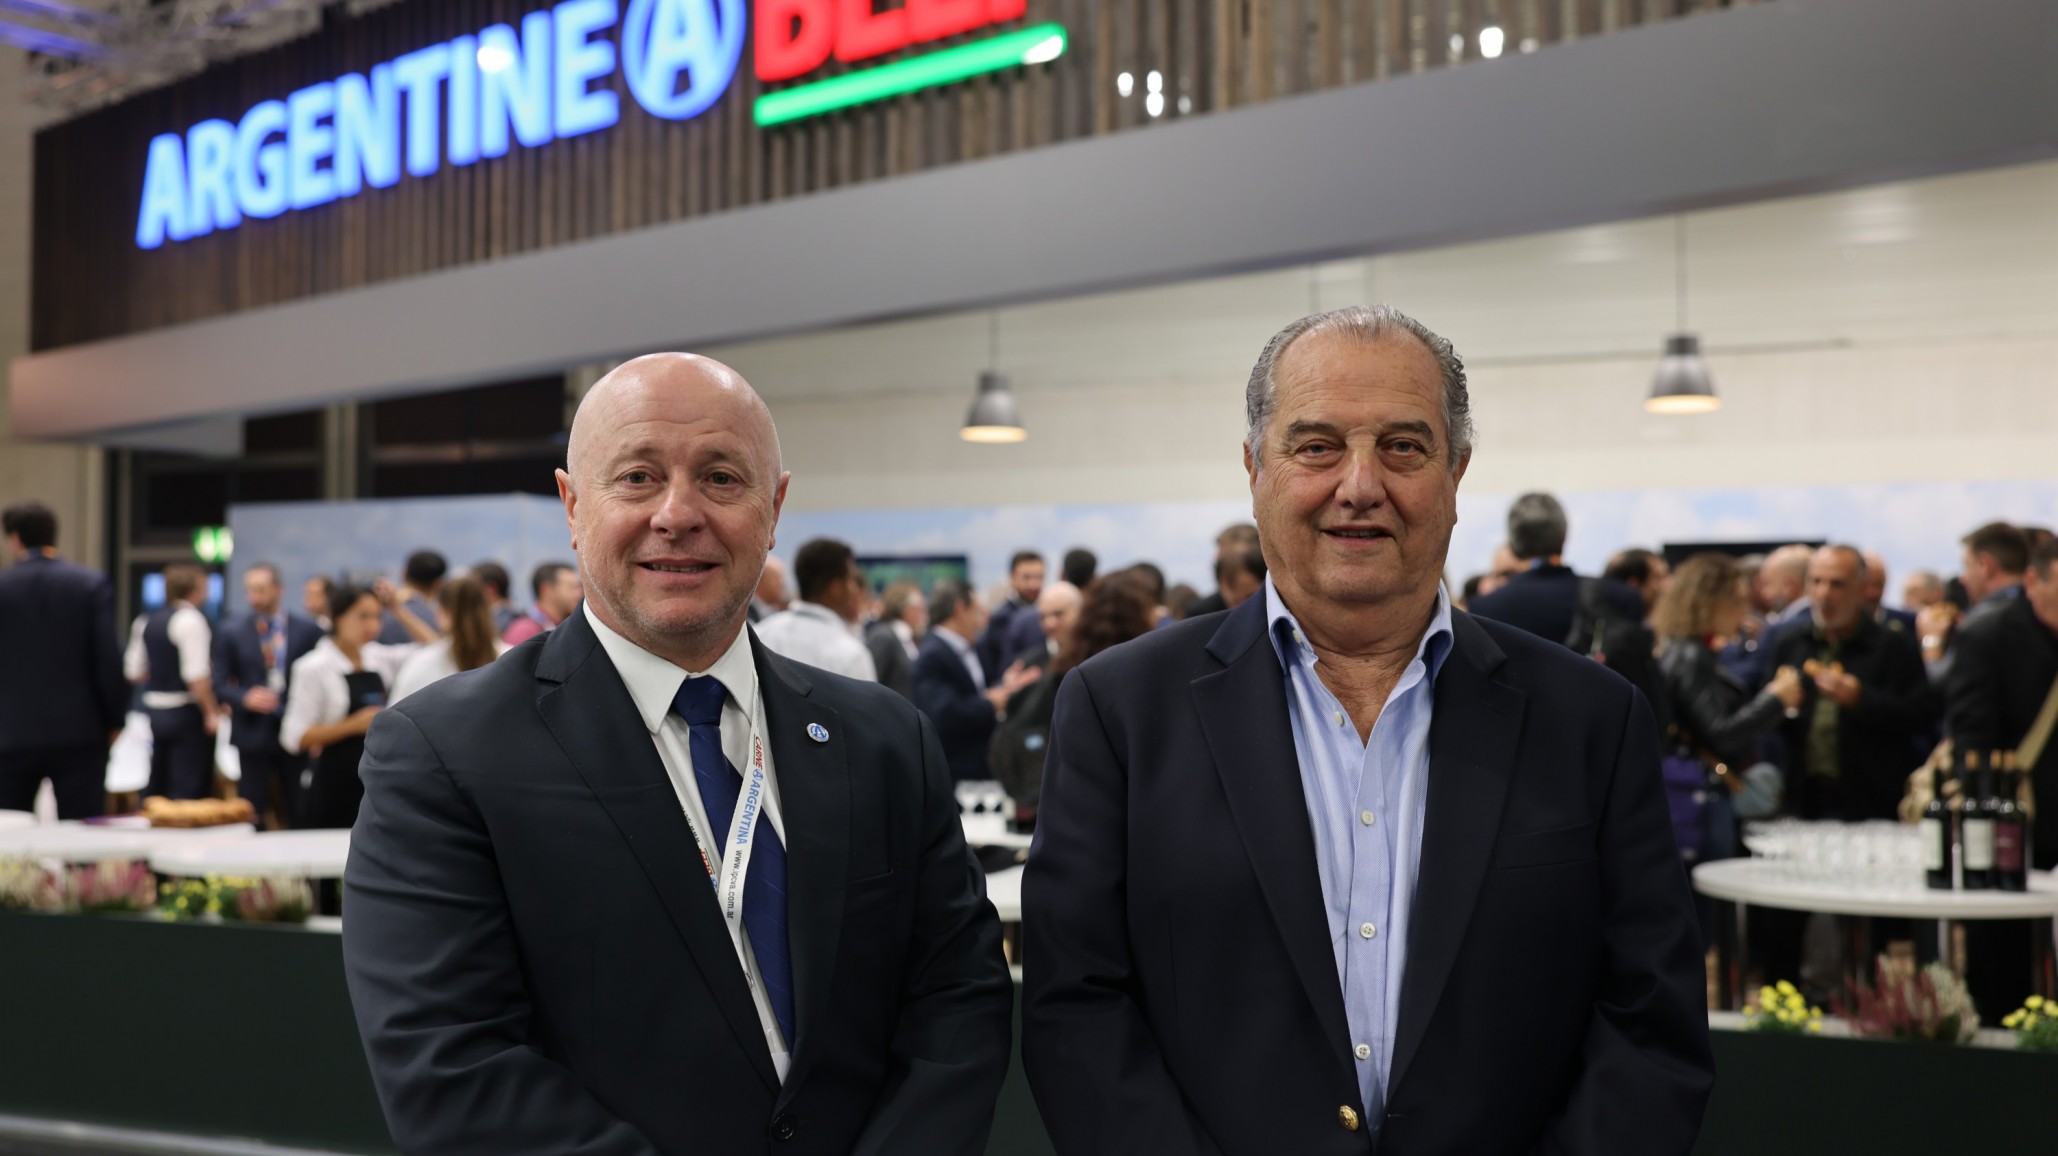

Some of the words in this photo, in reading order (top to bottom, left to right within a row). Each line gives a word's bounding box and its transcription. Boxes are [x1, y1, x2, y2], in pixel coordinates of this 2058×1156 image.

[135, 0, 620, 250] ARGENTINE
[755, 735, 763, 771] CARNE
[736, 779, 761, 845] ARGENTINA
[726, 849, 743, 919] www.ipcva.com.ar
